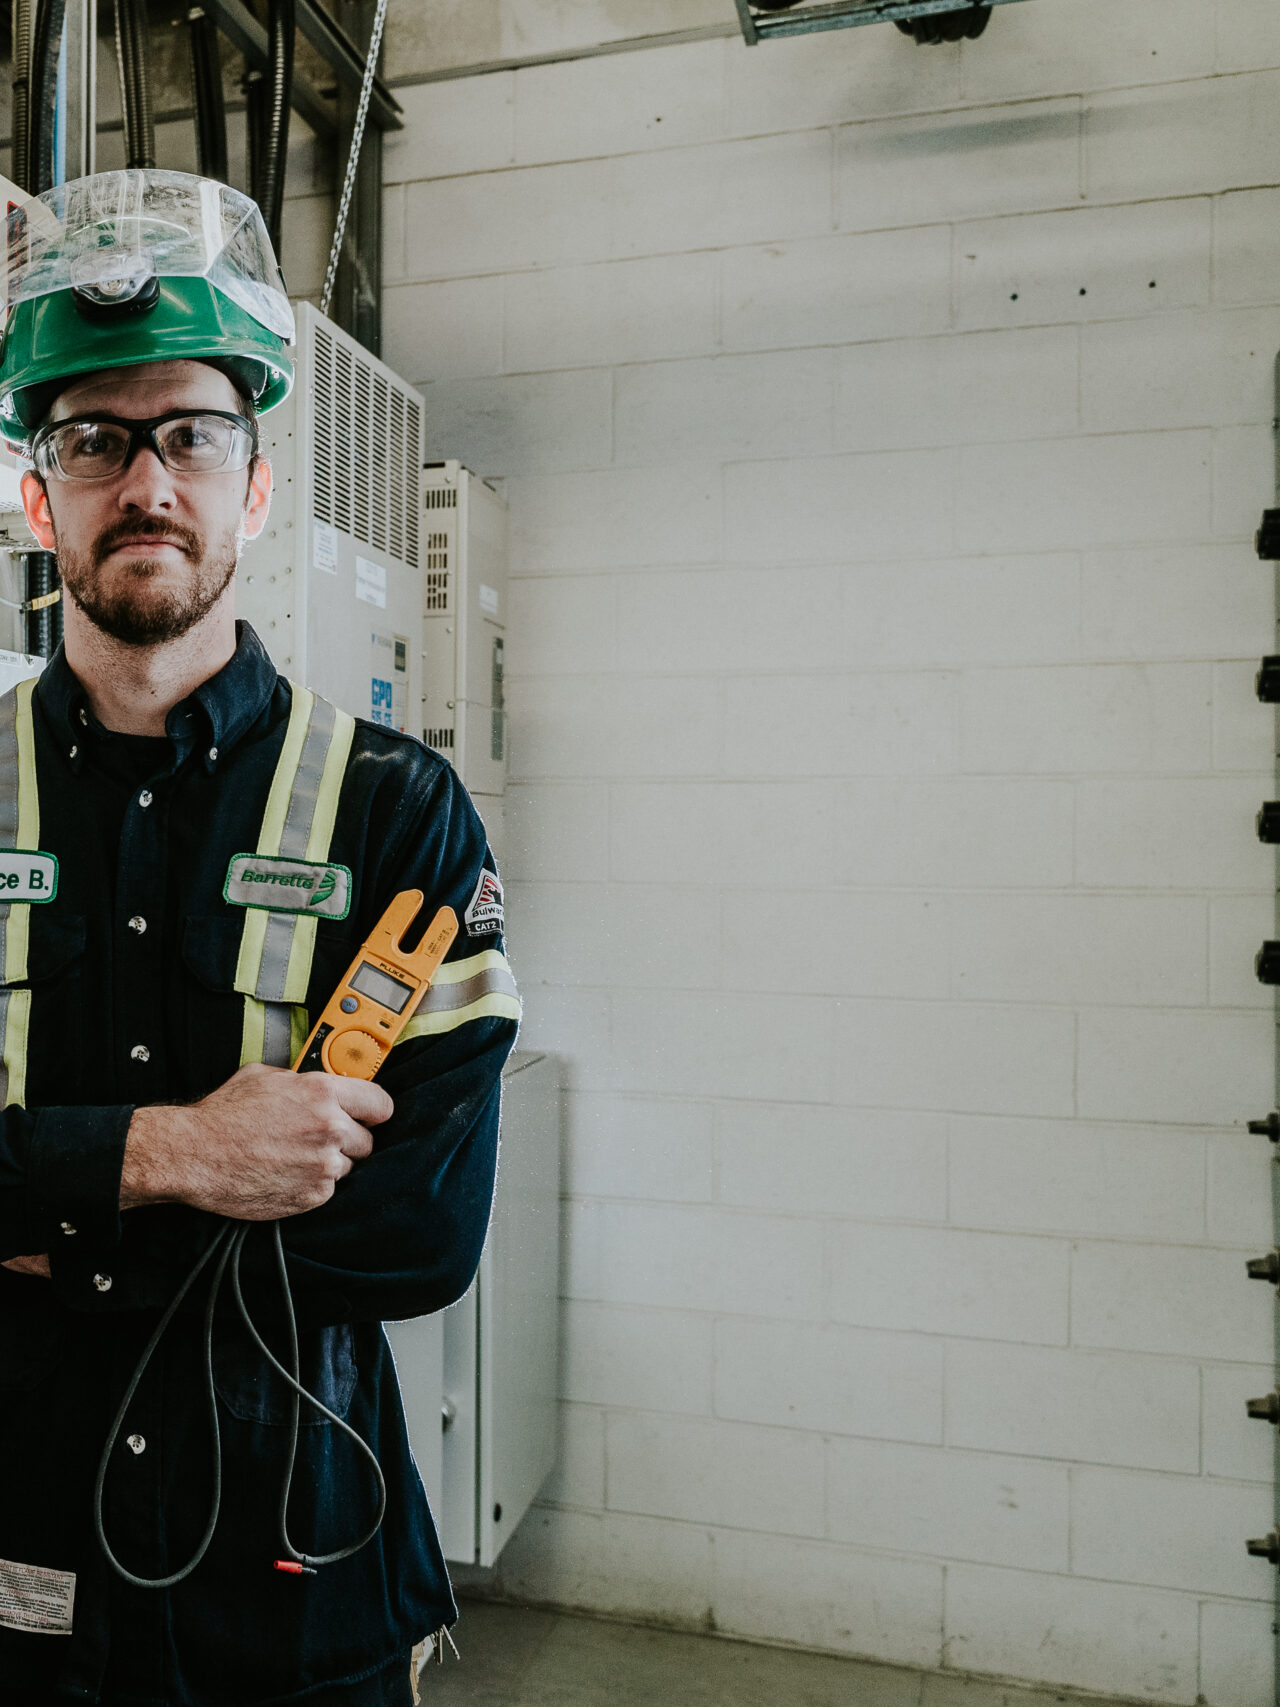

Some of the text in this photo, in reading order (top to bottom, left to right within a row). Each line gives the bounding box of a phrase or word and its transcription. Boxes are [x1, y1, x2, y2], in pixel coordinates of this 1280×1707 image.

[28, 869, 49, 890] B.
[241, 869, 314, 889] Barrette
[472, 906, 504, 918] Bulwar
[474, 921, 497, 931] CAT2
[380, 962, 406, 979] FLUKE
